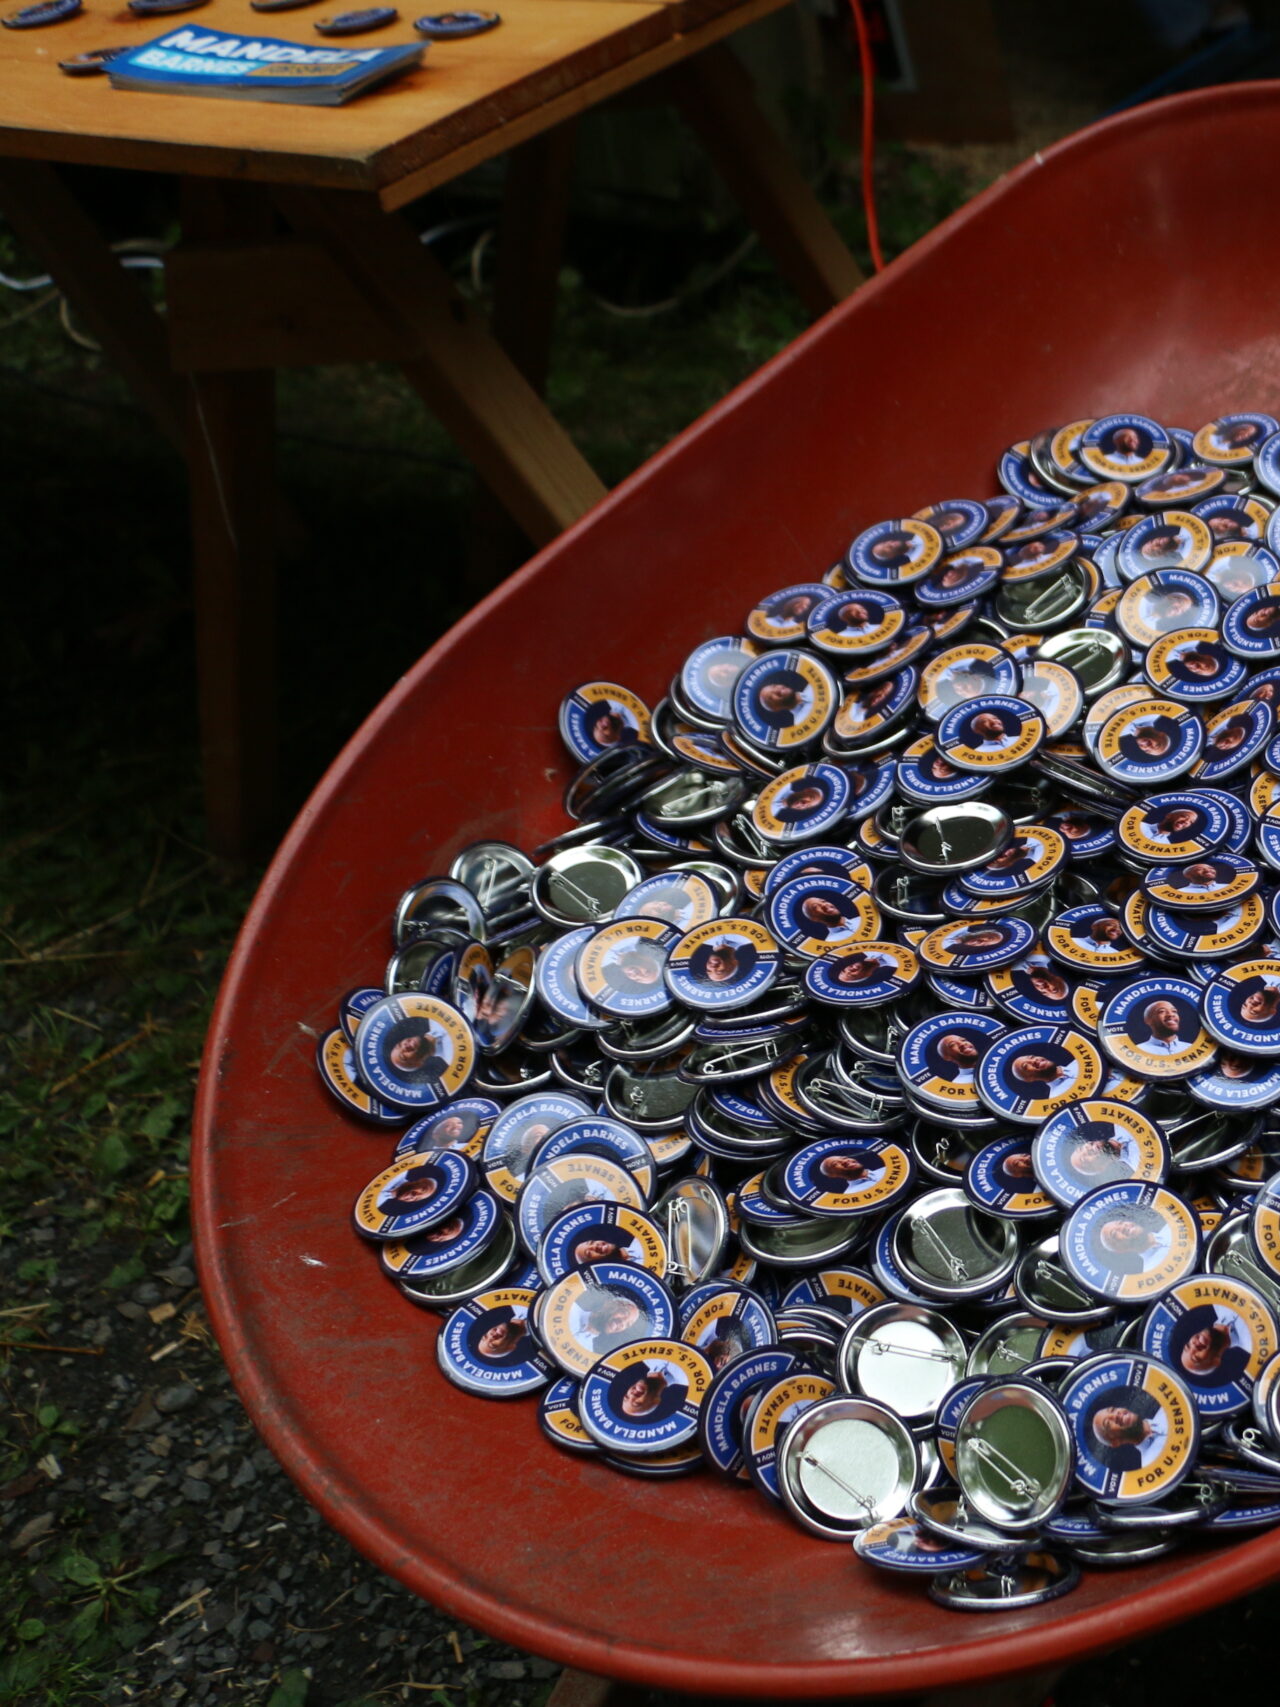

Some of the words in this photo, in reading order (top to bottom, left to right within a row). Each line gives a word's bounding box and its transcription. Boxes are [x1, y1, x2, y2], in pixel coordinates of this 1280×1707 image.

[137, 49, 258, 75] BARNES
[160, 31, 383, 63] MANDELA
[1228, 597, 1252, 627] BARNES
[1228, 626, 1263, 648] MANDELA
[744, 658, 778, 688] BARNES
[741, 687, 762, 732] MANDELA
[945, 702, 979, 733] MANDELA
[978, 700, 1020, 711] BARNES
[1125, 706, 1147, 718] U.S.
[1149, 704, 1172, 712] FOR
[960, 751, 983, 762] FOR
[986, 753, 1009, 761] U.S.
[1009, 727, 1035, 756] SENATE
[1105, 716, 1126, 748] SENATE
[1166, 727, 1194, 766] MANDELA
[1125, 761, 1169, 773] BARNES
[1125, 815, 1137, 831] FOR
[1160, 796, 1211, 808] MANDELA
[1205, 805, 1221, 833] BARNES
[1127, 831, 1142, 845] U.S.
[1140, 843, 1186, 853] SENATE
[778, 887, 799, 928] MANDELA
[794, 879, 839, 892] BARNES
[748, 927, 767, 944] FOR
[860, 904, 874, 938] SENATE
[553, 935, 583, 967] BARNES
[683, 924, 723, 950] SENATE
[549, 963, 577, 1012] MANDELA
[677, 974, 713, 998] BARNES
[713, 969, 765, 998] MANDELA
[1222, 978, 1236, 988] NOV
[1113, 983, 1162, 1015] MANDELA
[1212, 994, 1234, 1030] BARNES
[416, 1002, 459, 1028] SENATE
[367, 1019, 387, 1066] BARNES
[455, 1028, 466, 1052] U.S.
[909, 1022, 940, 1064] MANDELA
[937, 1017, 986, 1028] BARNES
[996, 1031, 1041, 1056] BARNES
[451, 1055, 467, 1079] FOR
[987, 1053, 1008, 1101] MANDELA
[1073, 1043, 1094, 1080] SENATE
[371, 1064, 421, 1098] MANDELA
[938, 1085, 966, 1096] FOR
[1069, 1082, 1089, 1101] U.S.
[792, 1150, 818, 1188] MANDELA
[813, 1139, 864, 1153] BARNES
[831, 1196, 861, 1204] FOR
[863, 1186, 888, 1200] U.S.
[885, 1154, 901, 1186] SENATE
[1081, 1190, 1128, 1222] BARNES
[555, 1213, 593, 1247] BARNES
[1164, 1203, 1188, 1248] SENATE
[1074, 1220, 1099, 1277] MANDELA
[450, 1320, 468, 1362] BARNES
[621, 1346, 675, 1362] SENATE
[460, 1358, 523, 1380] MANDELA
[675, 1351, 698, 1369] U.S.
[692, 1368, 705, 1392] FOR
[1071, 1369, 1117, 1411] BARNES
[591, 1388, 616, 1429] BARNES
[713, 1389, 734, 1452] MANDELA
[731, 1361, 778, 1389] BARNES
[1156, 1381, 1185, 1436] SENATE
[610, 1420, 677, 1438] MANDELA
[1163, 1439, 1183, 1468] U.S.
[1107, 1471, 1119, 1493] VOTE
[1136, 1466, 1166, 1488] FOR
